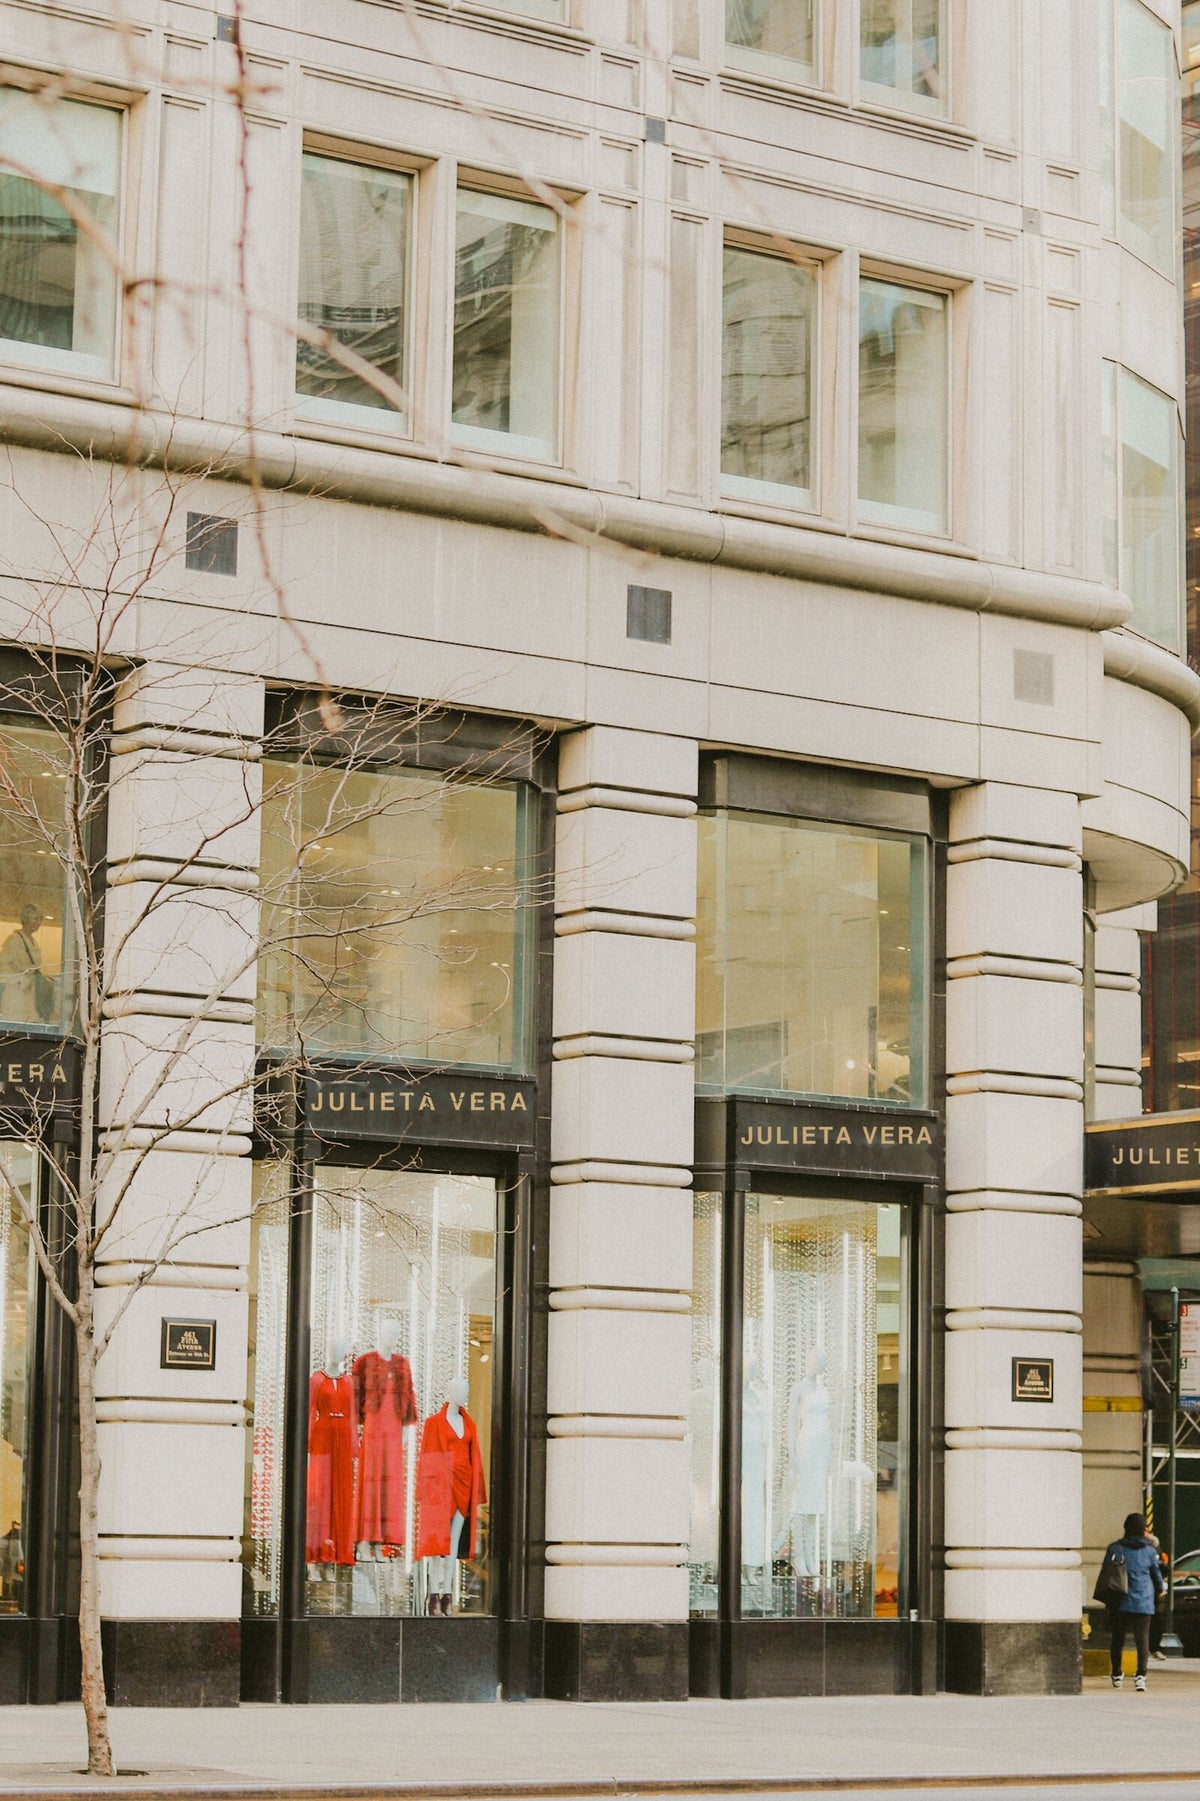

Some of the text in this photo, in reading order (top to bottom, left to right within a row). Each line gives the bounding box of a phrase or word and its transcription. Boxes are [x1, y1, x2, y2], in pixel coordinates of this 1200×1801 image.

[0, 1063, 67, 1083] ERA
[310, 1091, 528, 1112] JULIETA VERA
[740, 1125, 933, 1146] JULIETA VERA
[176, 1342, 203, 1351] Avenue
